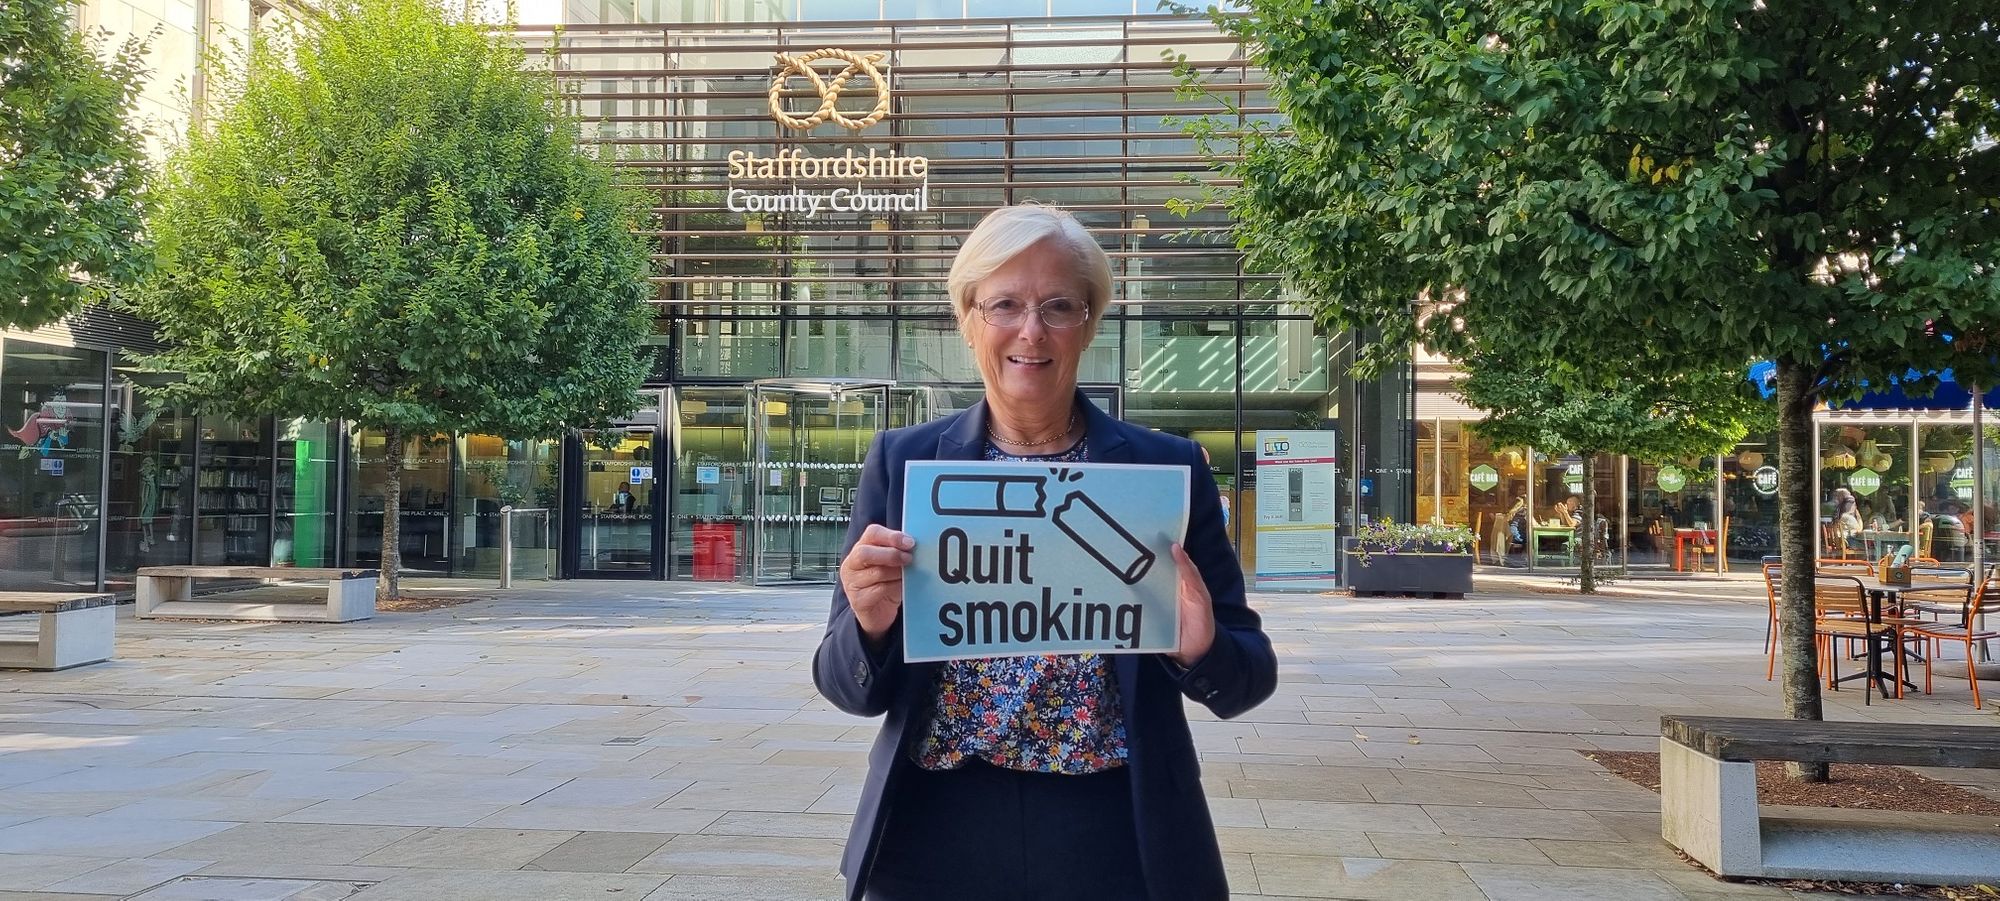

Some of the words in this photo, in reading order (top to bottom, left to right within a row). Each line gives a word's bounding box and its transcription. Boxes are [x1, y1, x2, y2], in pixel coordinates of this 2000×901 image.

[727, 148, 927, 179] Staffordshire
[727, 187, 820, 218] County
[830, 186, 928, 212] Council
[1486, 474, 1499, 483] BAR
[1867, 477, 1880, 486] BAR
[1958, 487, 1973, 498] BAR
[938, 527, 1034, 585] Quit
[938, 586, 1143, 649] smoking
